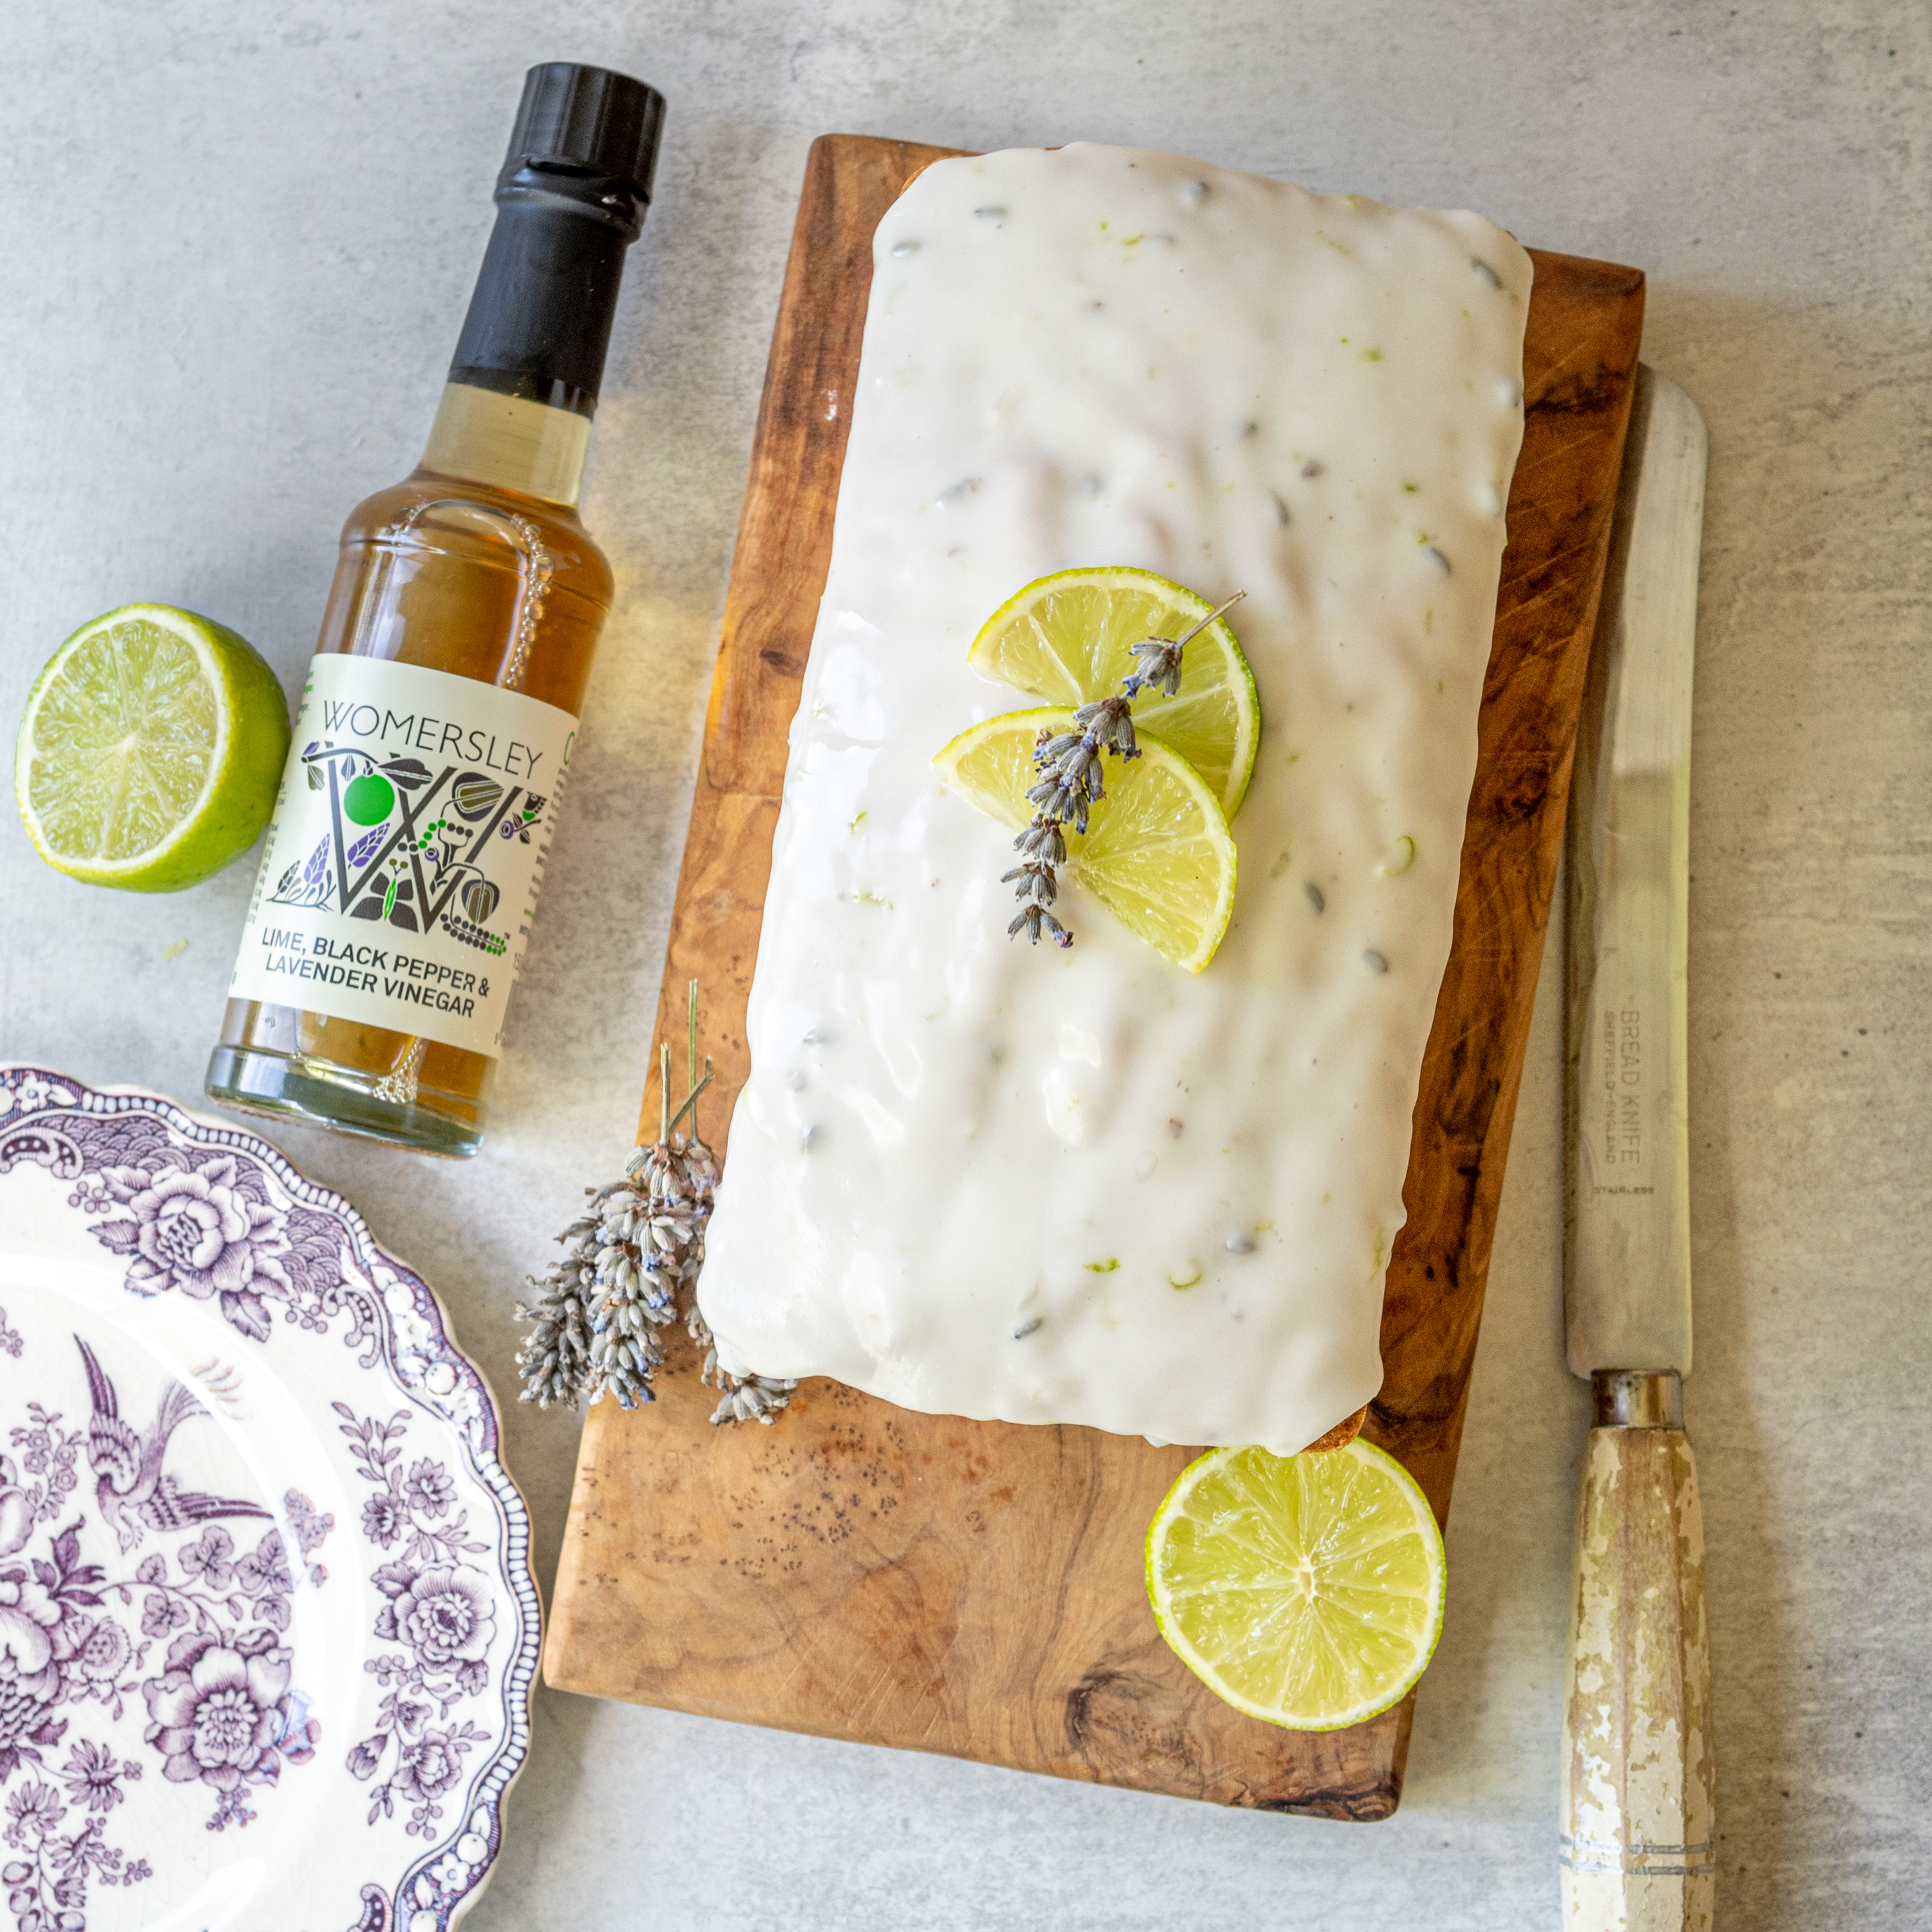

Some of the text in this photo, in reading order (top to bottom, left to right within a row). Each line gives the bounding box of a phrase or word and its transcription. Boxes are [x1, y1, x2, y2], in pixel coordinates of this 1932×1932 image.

[324, 700, 543, 779] WOMERSLEY
[261, 927, 306, 956] LIME,
[312, 936, 390, 971] BLACK
[392, 954, 476, 993] PEPPER
[478, 978, 490, 998] &
[265, 953, 475, 1018] LAVENDER VINEGAR
[1620, 1010, 1640, 1164] BREAD KNIFE
